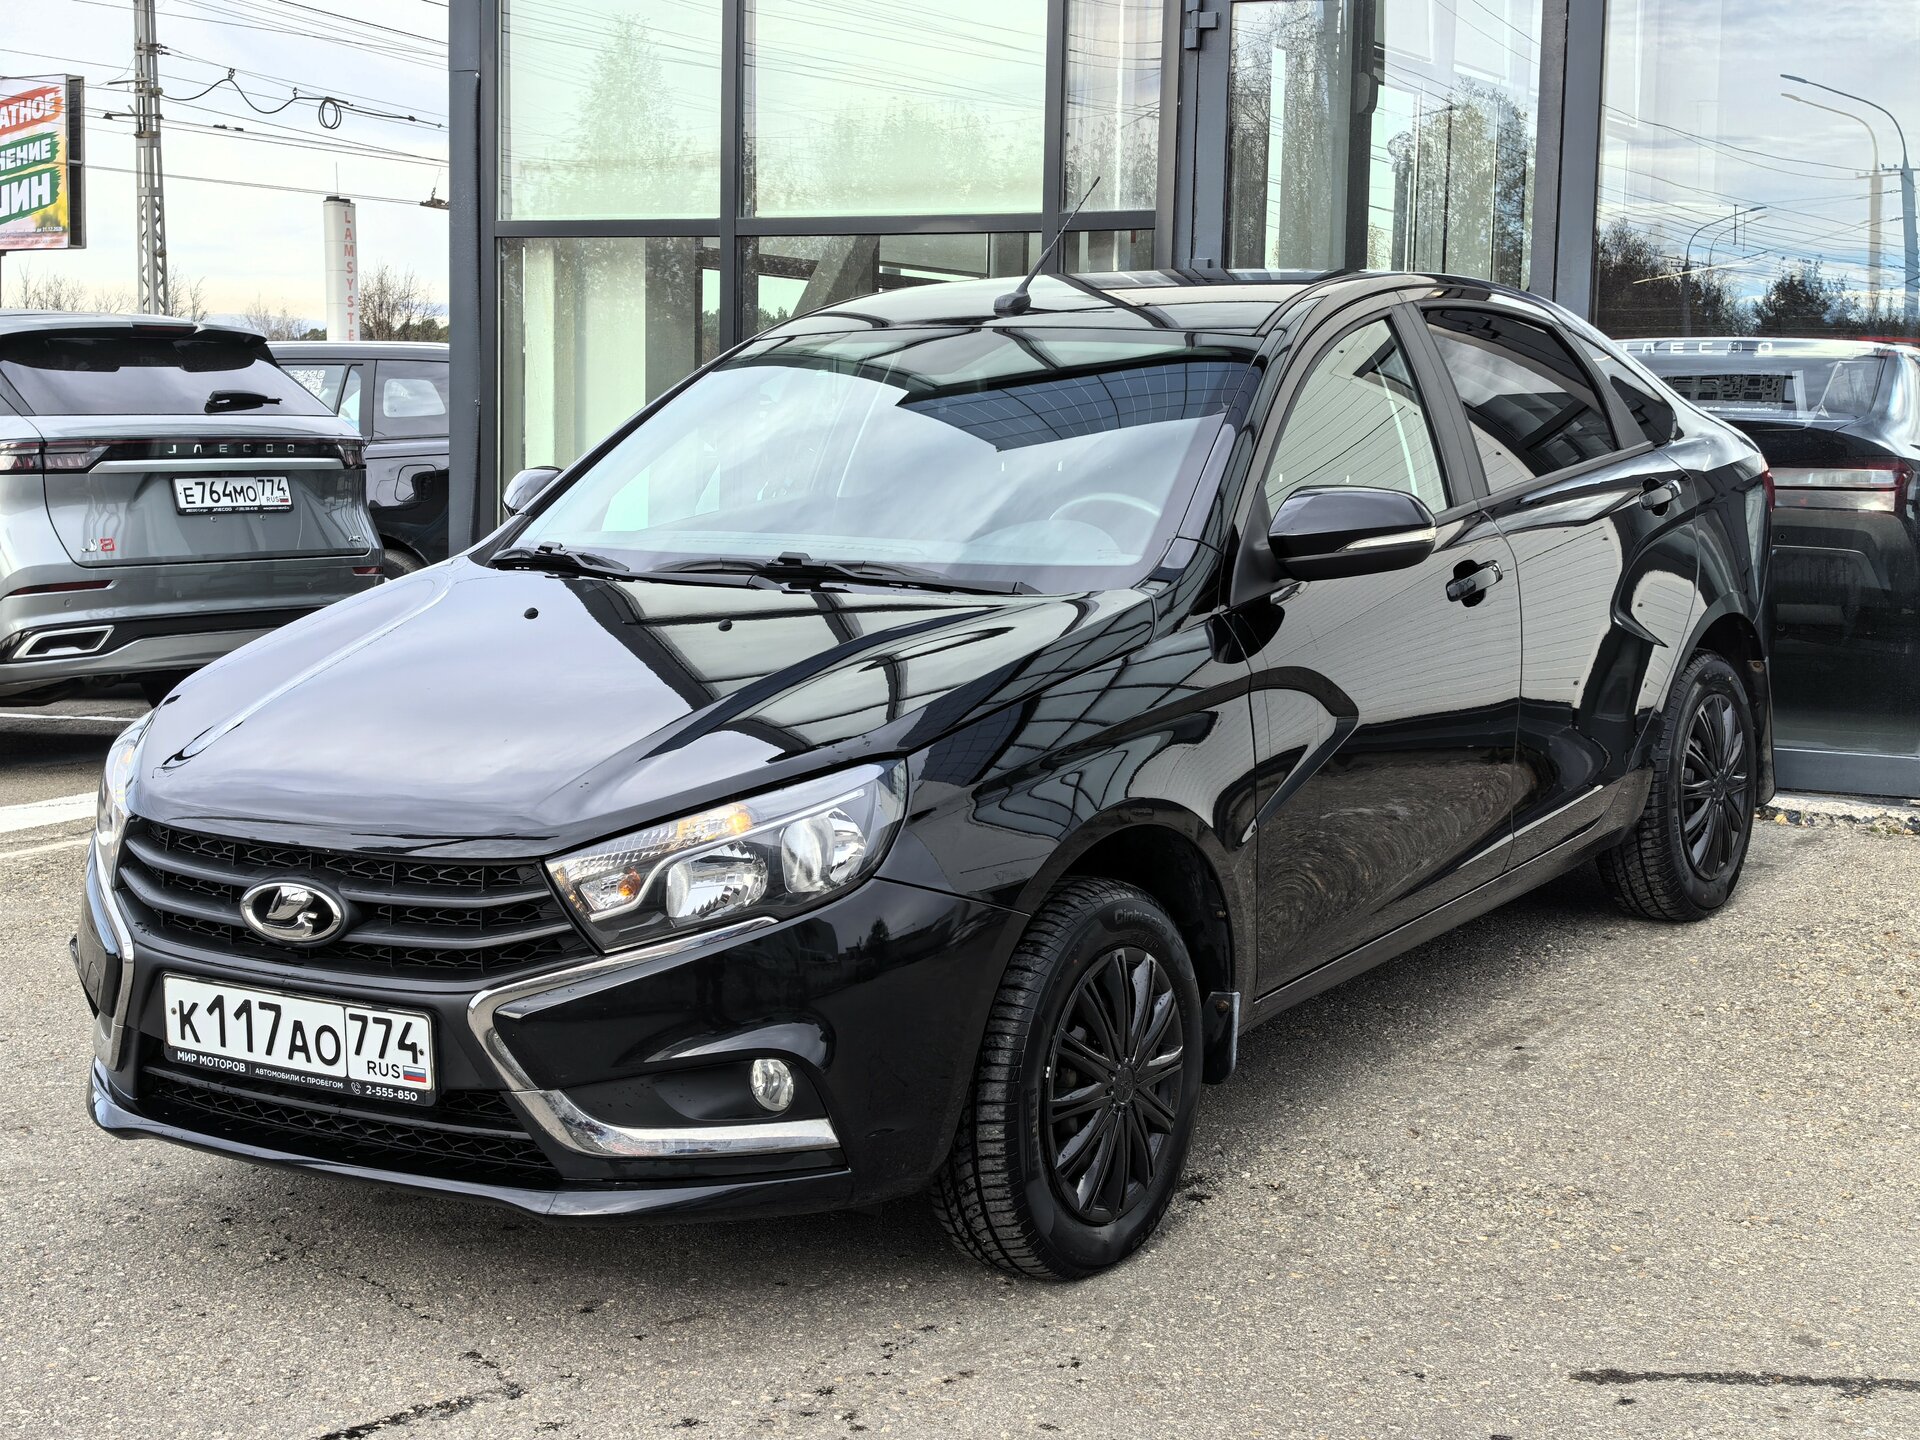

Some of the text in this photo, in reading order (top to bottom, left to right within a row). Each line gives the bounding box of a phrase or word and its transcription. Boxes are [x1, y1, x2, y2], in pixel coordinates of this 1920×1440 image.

[167, 444, 295, 454] JAECOO
[258, 479, 286, 496] 774
[178, 994, 418, 1067] К117АО 774
[177, 1050, 198, 1064] МИР
[199, 1055, 246, 1073] МОТОРОВ
[255, 1067, 300, 1082] АВТОМОБИЛИ
[306, 1077, 344, 1090] ПРОБЕГОМ
[365, 1085, 418, 1102] 2-555-850
[367, 1060, 401, 1079] RUS
